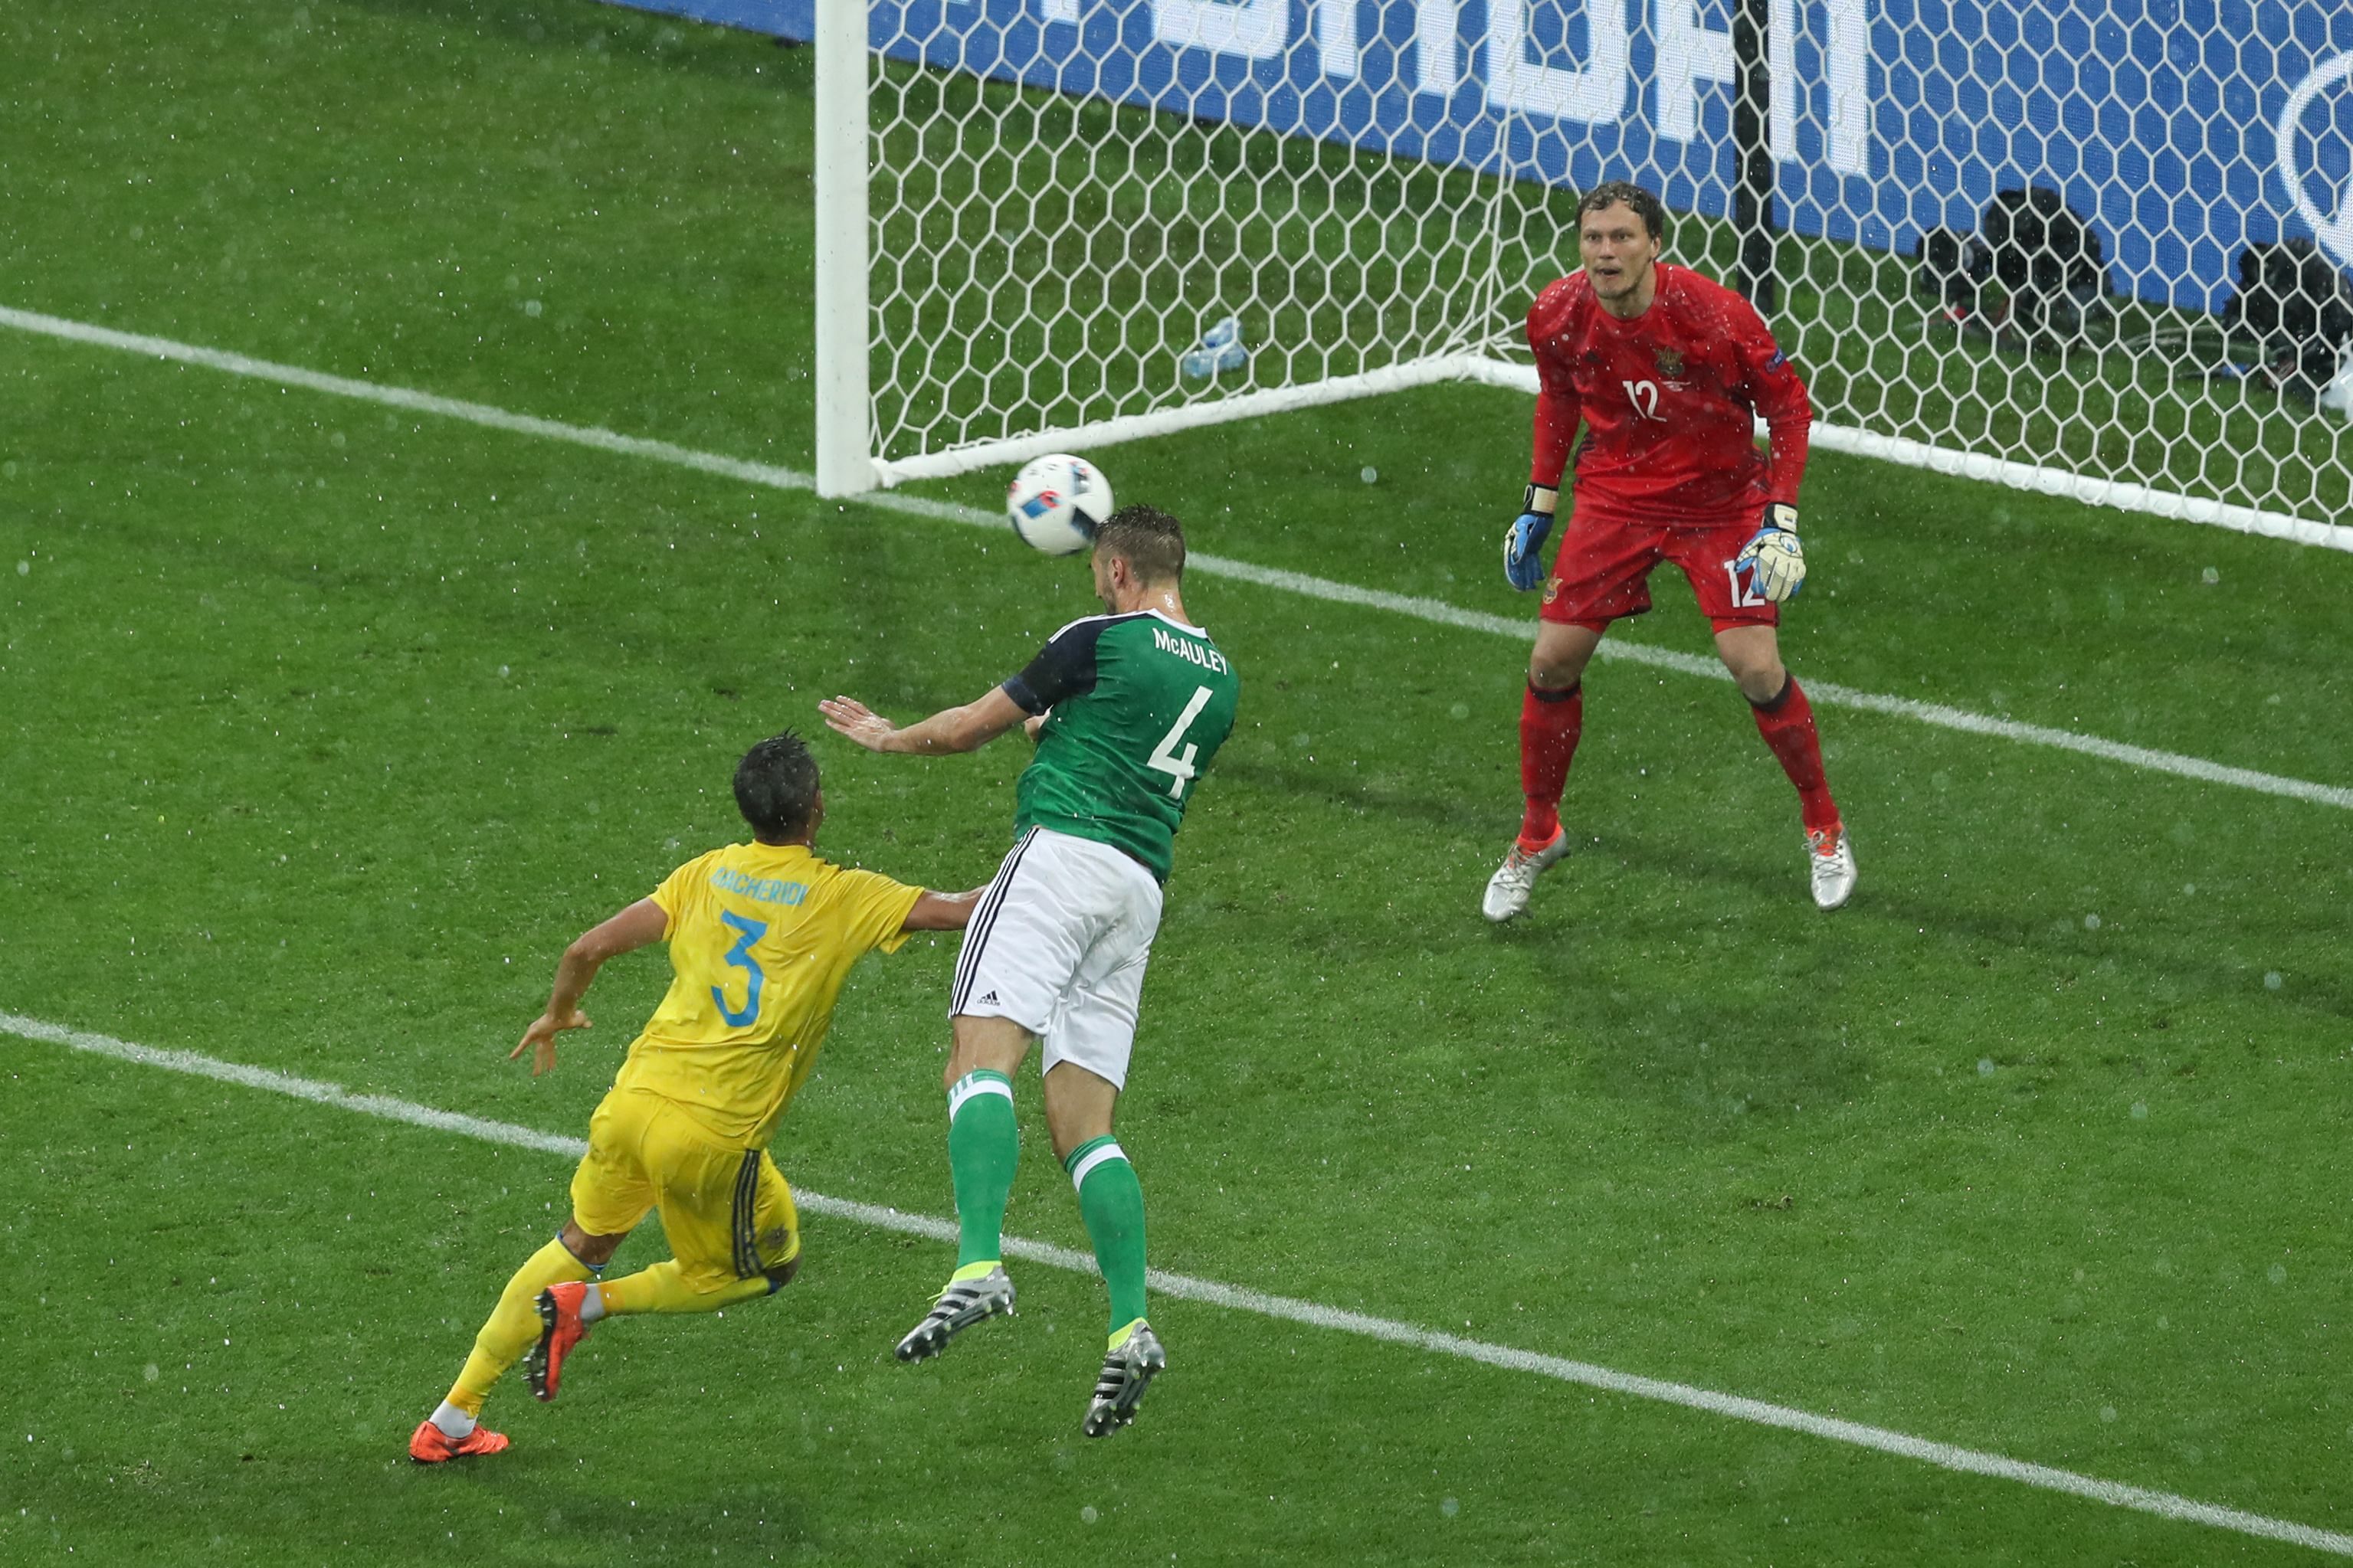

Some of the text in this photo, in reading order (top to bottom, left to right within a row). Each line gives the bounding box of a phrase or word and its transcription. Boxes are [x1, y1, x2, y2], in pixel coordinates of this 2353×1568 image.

[1622, 380, 1667, 422] 12
[1152, 627, 1228, 676] McAULEY
[1147, 686, 1214, 800] 4
[710, 909, 768, 1027] 3
